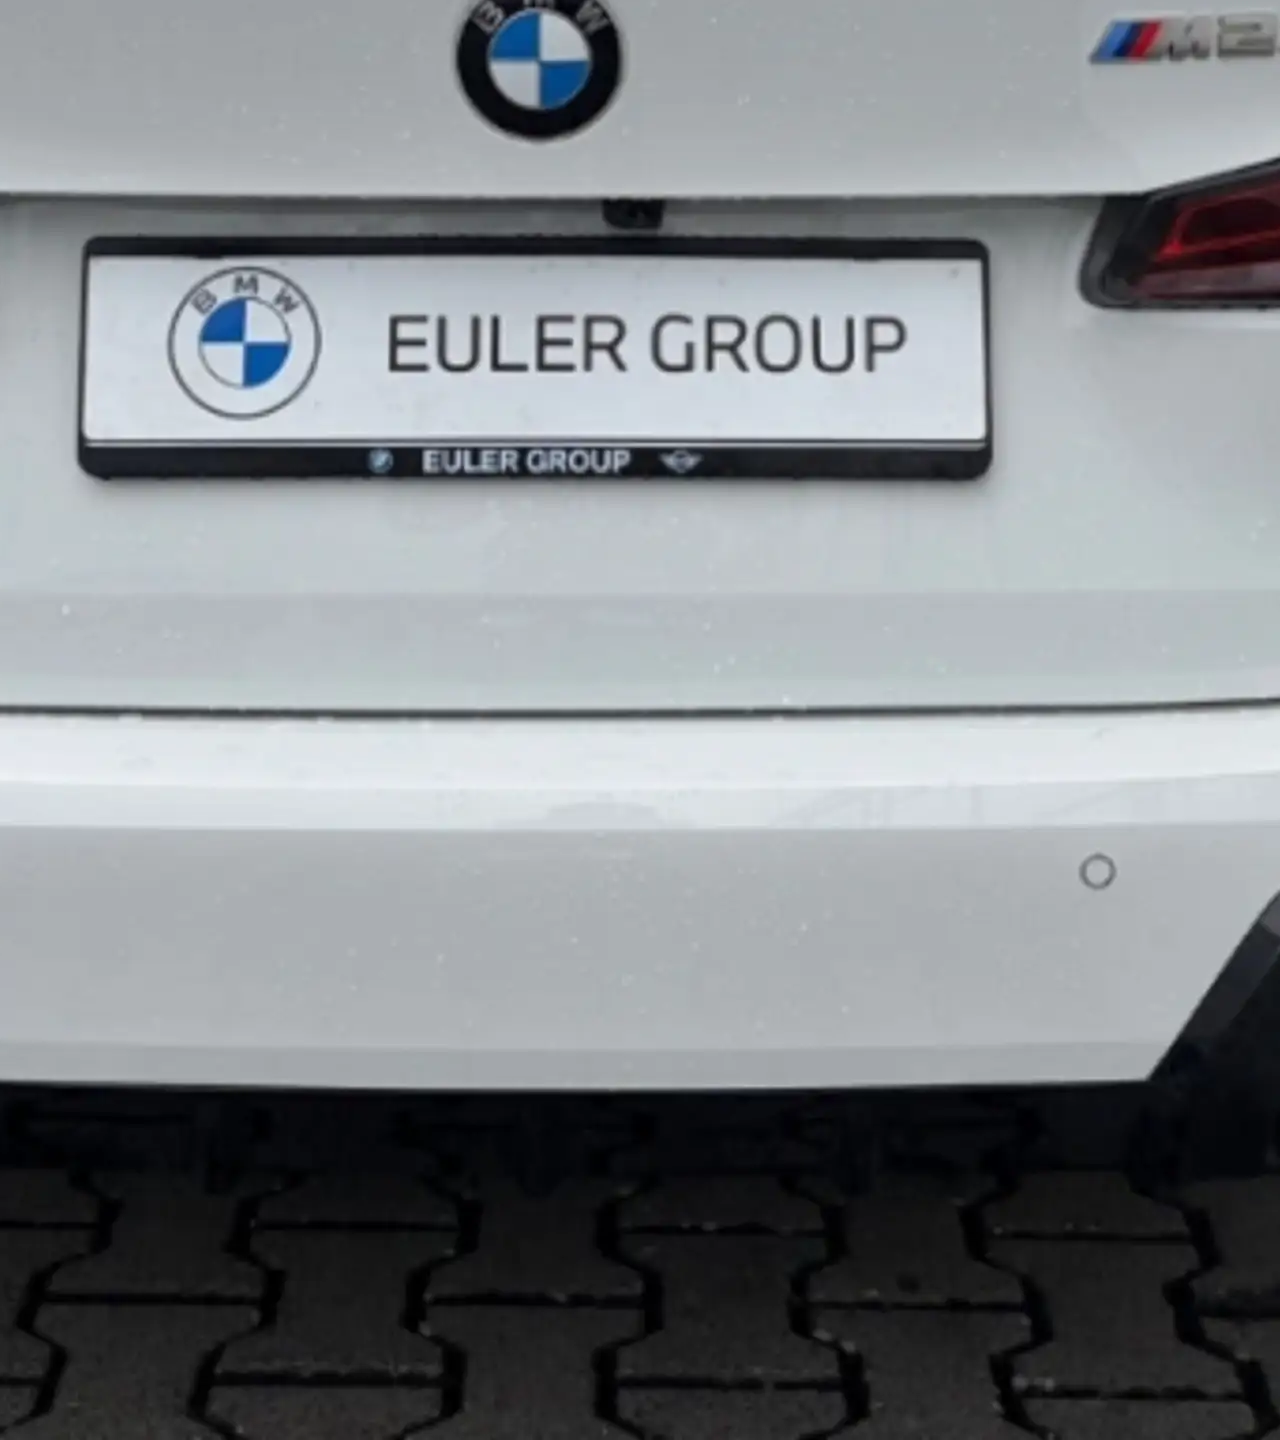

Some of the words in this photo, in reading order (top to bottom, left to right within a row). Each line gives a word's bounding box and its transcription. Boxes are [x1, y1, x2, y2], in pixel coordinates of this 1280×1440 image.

[190, 273, 300, 316] BMW
[387, 313, 627, 374] EULER
[649, 314, 908, 374] GROUP
[422, 449, 520, 474] EULER
[526, 449, 631, 474] GROUP
